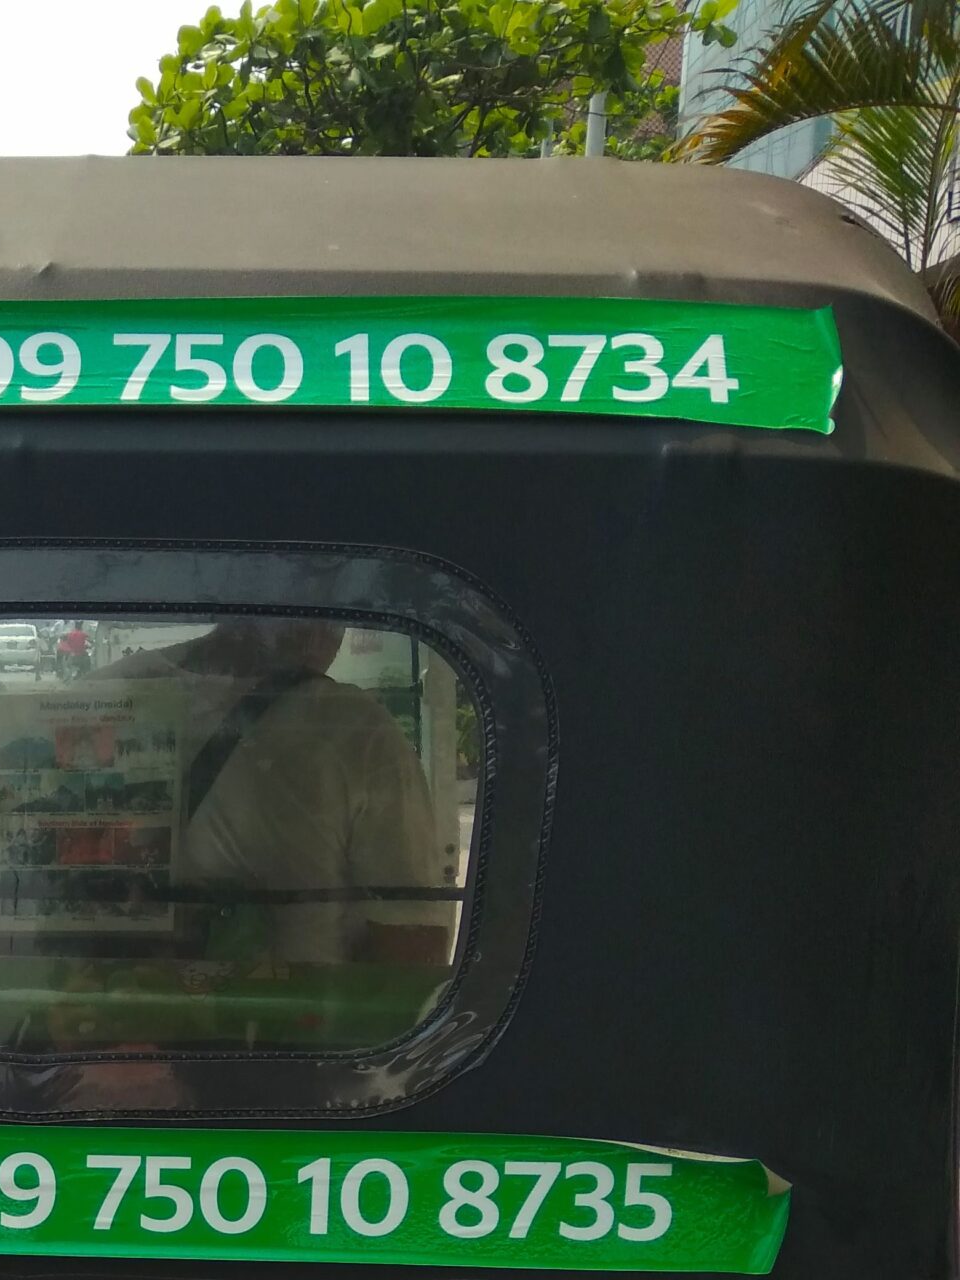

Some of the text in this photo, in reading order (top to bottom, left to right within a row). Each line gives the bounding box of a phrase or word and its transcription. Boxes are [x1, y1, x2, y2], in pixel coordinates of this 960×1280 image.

[112, 332, 305, 403] 750
[335, 332, 453, 403] 10
[484, 332, 739, 403] 8734
[86, 1154, 268, 1235] 750
[296, 1156, 410, 1237] 10
[439, 1159, 674, 1242] 8735
